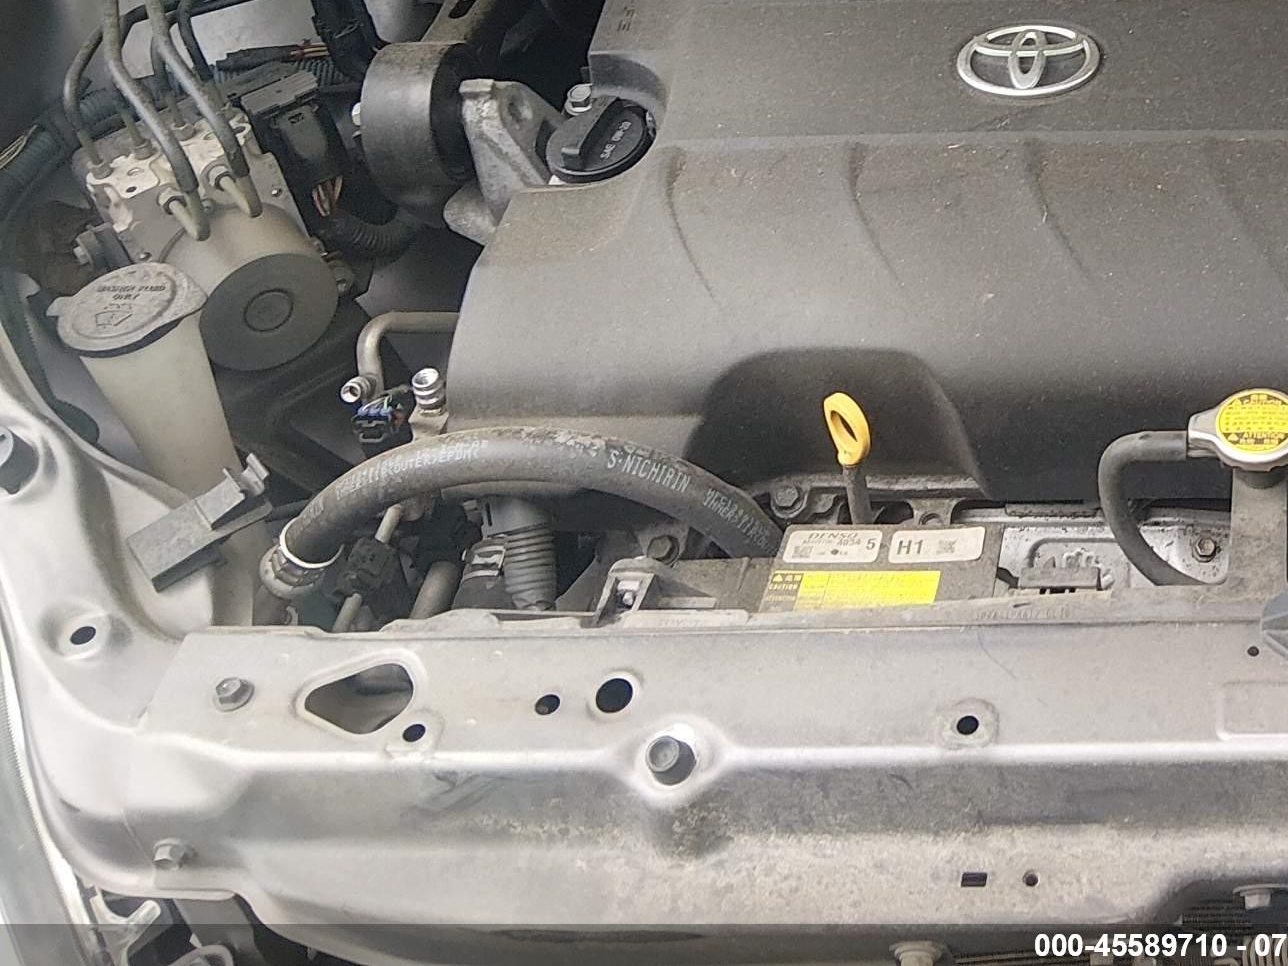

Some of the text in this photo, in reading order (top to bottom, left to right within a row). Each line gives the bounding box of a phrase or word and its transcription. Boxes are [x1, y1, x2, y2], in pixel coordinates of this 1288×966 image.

[600, 143, 616, 159] SAE
[865, 538, 877, 550] 5
[897, 539, 923, 554] H1
